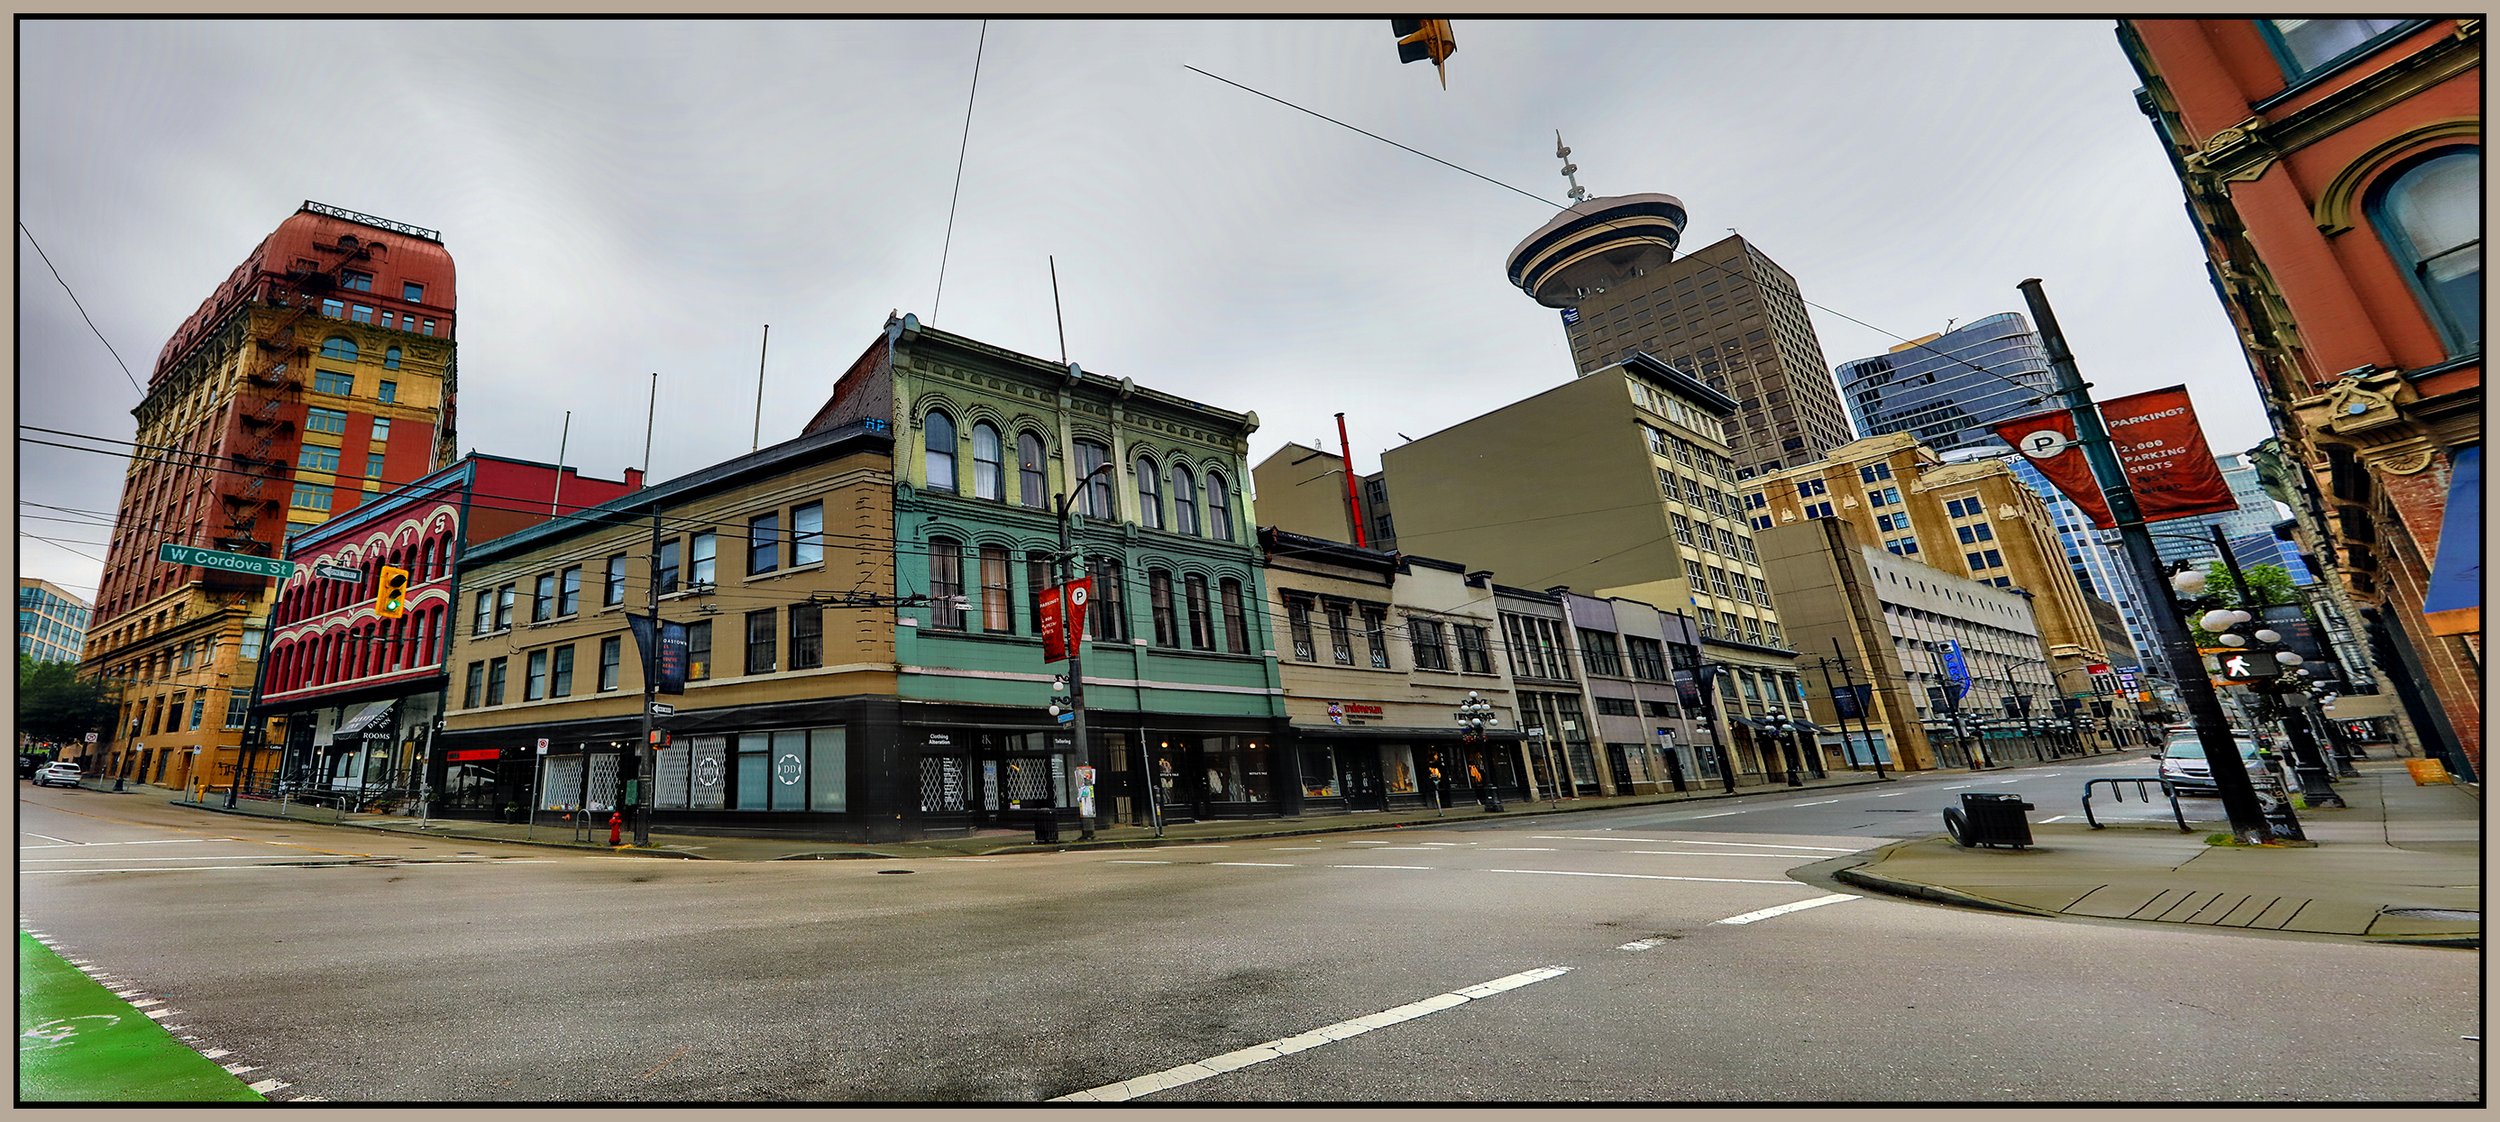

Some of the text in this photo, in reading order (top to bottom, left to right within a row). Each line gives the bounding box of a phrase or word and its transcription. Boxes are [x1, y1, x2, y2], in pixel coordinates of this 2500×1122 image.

[2110, 407, 2185, 428] PARKING?
[2034, 437, 2054, 452] P
[2124, 446, 2186, 463] PARKING
[2130, 461, 2173, 474] SPOTS
[171, 548, 287, 575] W Cordova St
[1076, 592, 1083, 601] P
[929, 733, 949, 741] Clothing
[784, 764, 797, 774] DD
